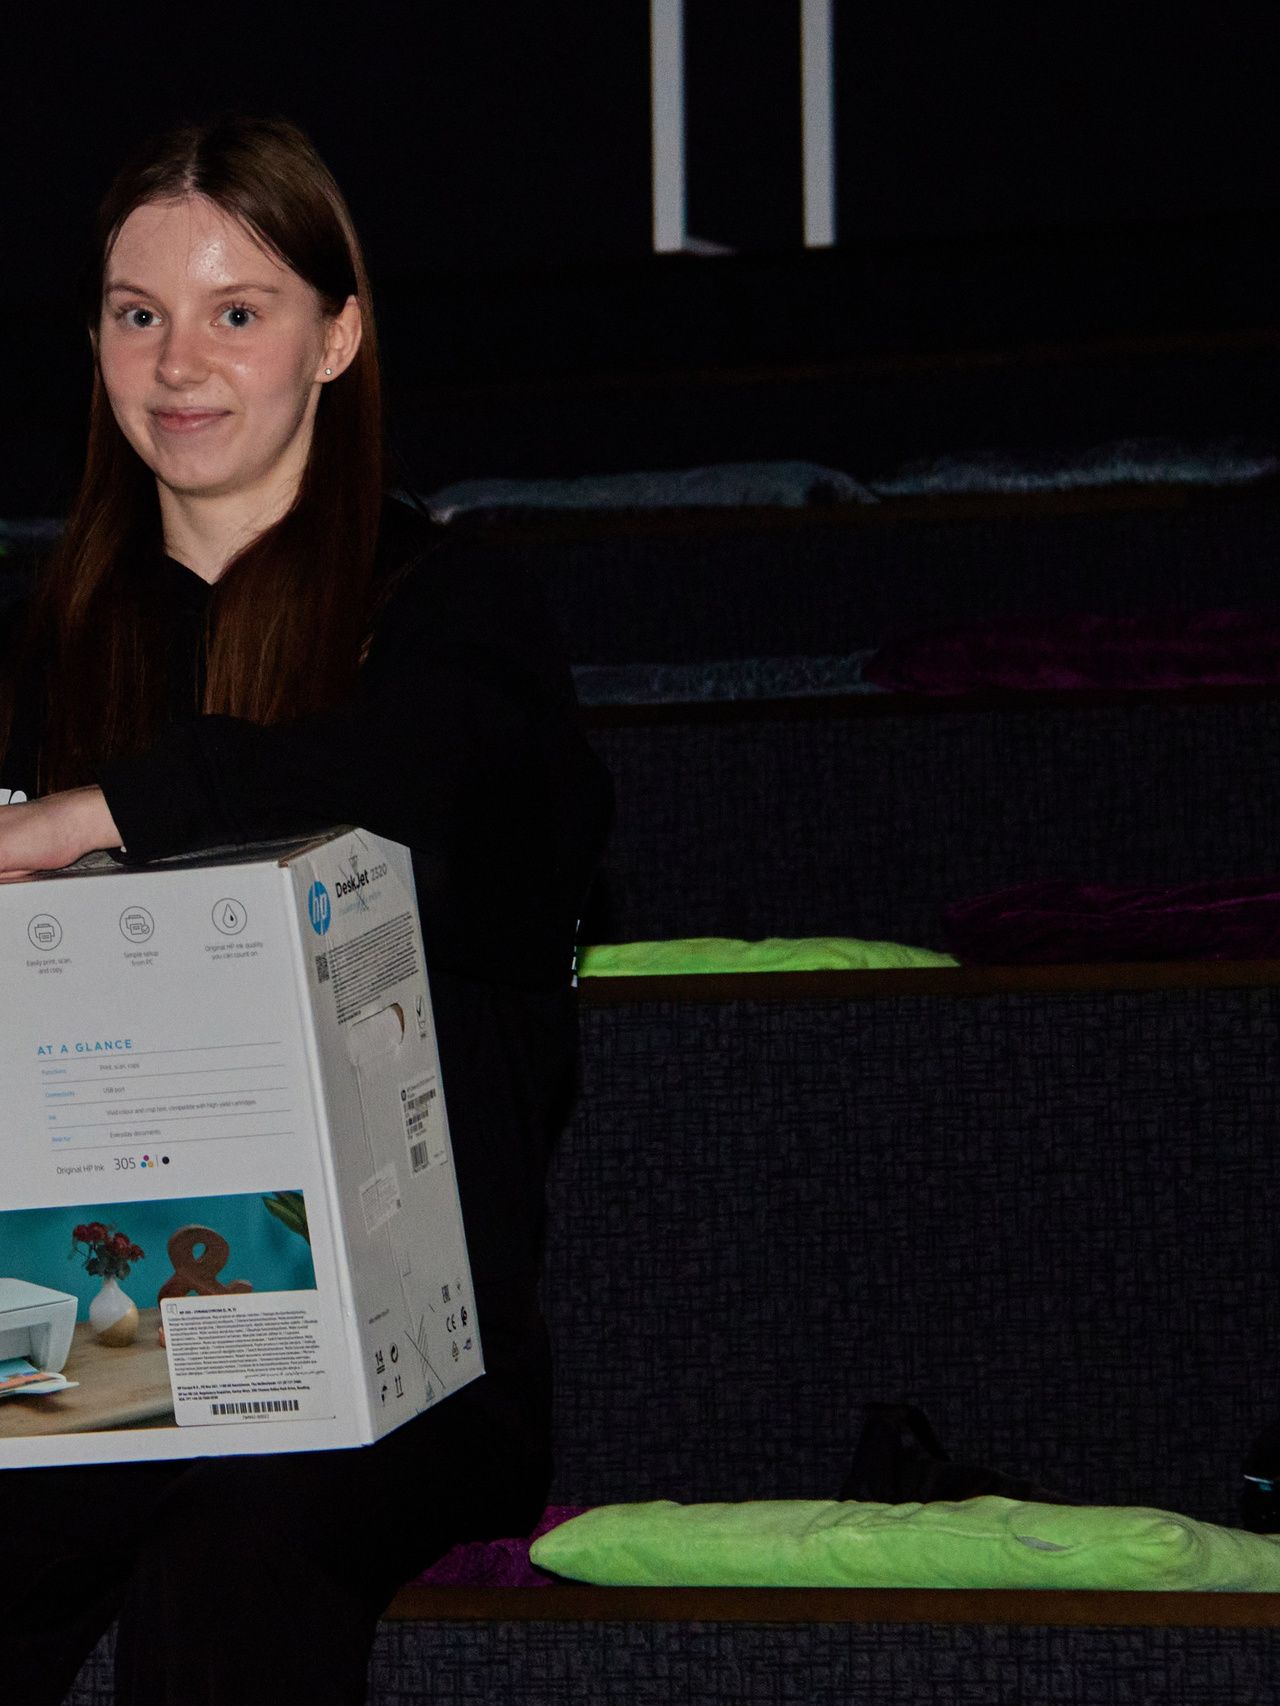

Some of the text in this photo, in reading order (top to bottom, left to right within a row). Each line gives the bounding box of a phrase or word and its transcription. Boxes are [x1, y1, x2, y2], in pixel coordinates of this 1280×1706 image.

[335, 869, 370, 898] DeskJet
[308, 881, 331, 935] hp
[37, 1039, 132, 1055] AT A GLANCE
[56, 1165, 82, 1175] Original
[83, 1164, 93, 1172] HP
[114, 1157, 136, 1171] 305
